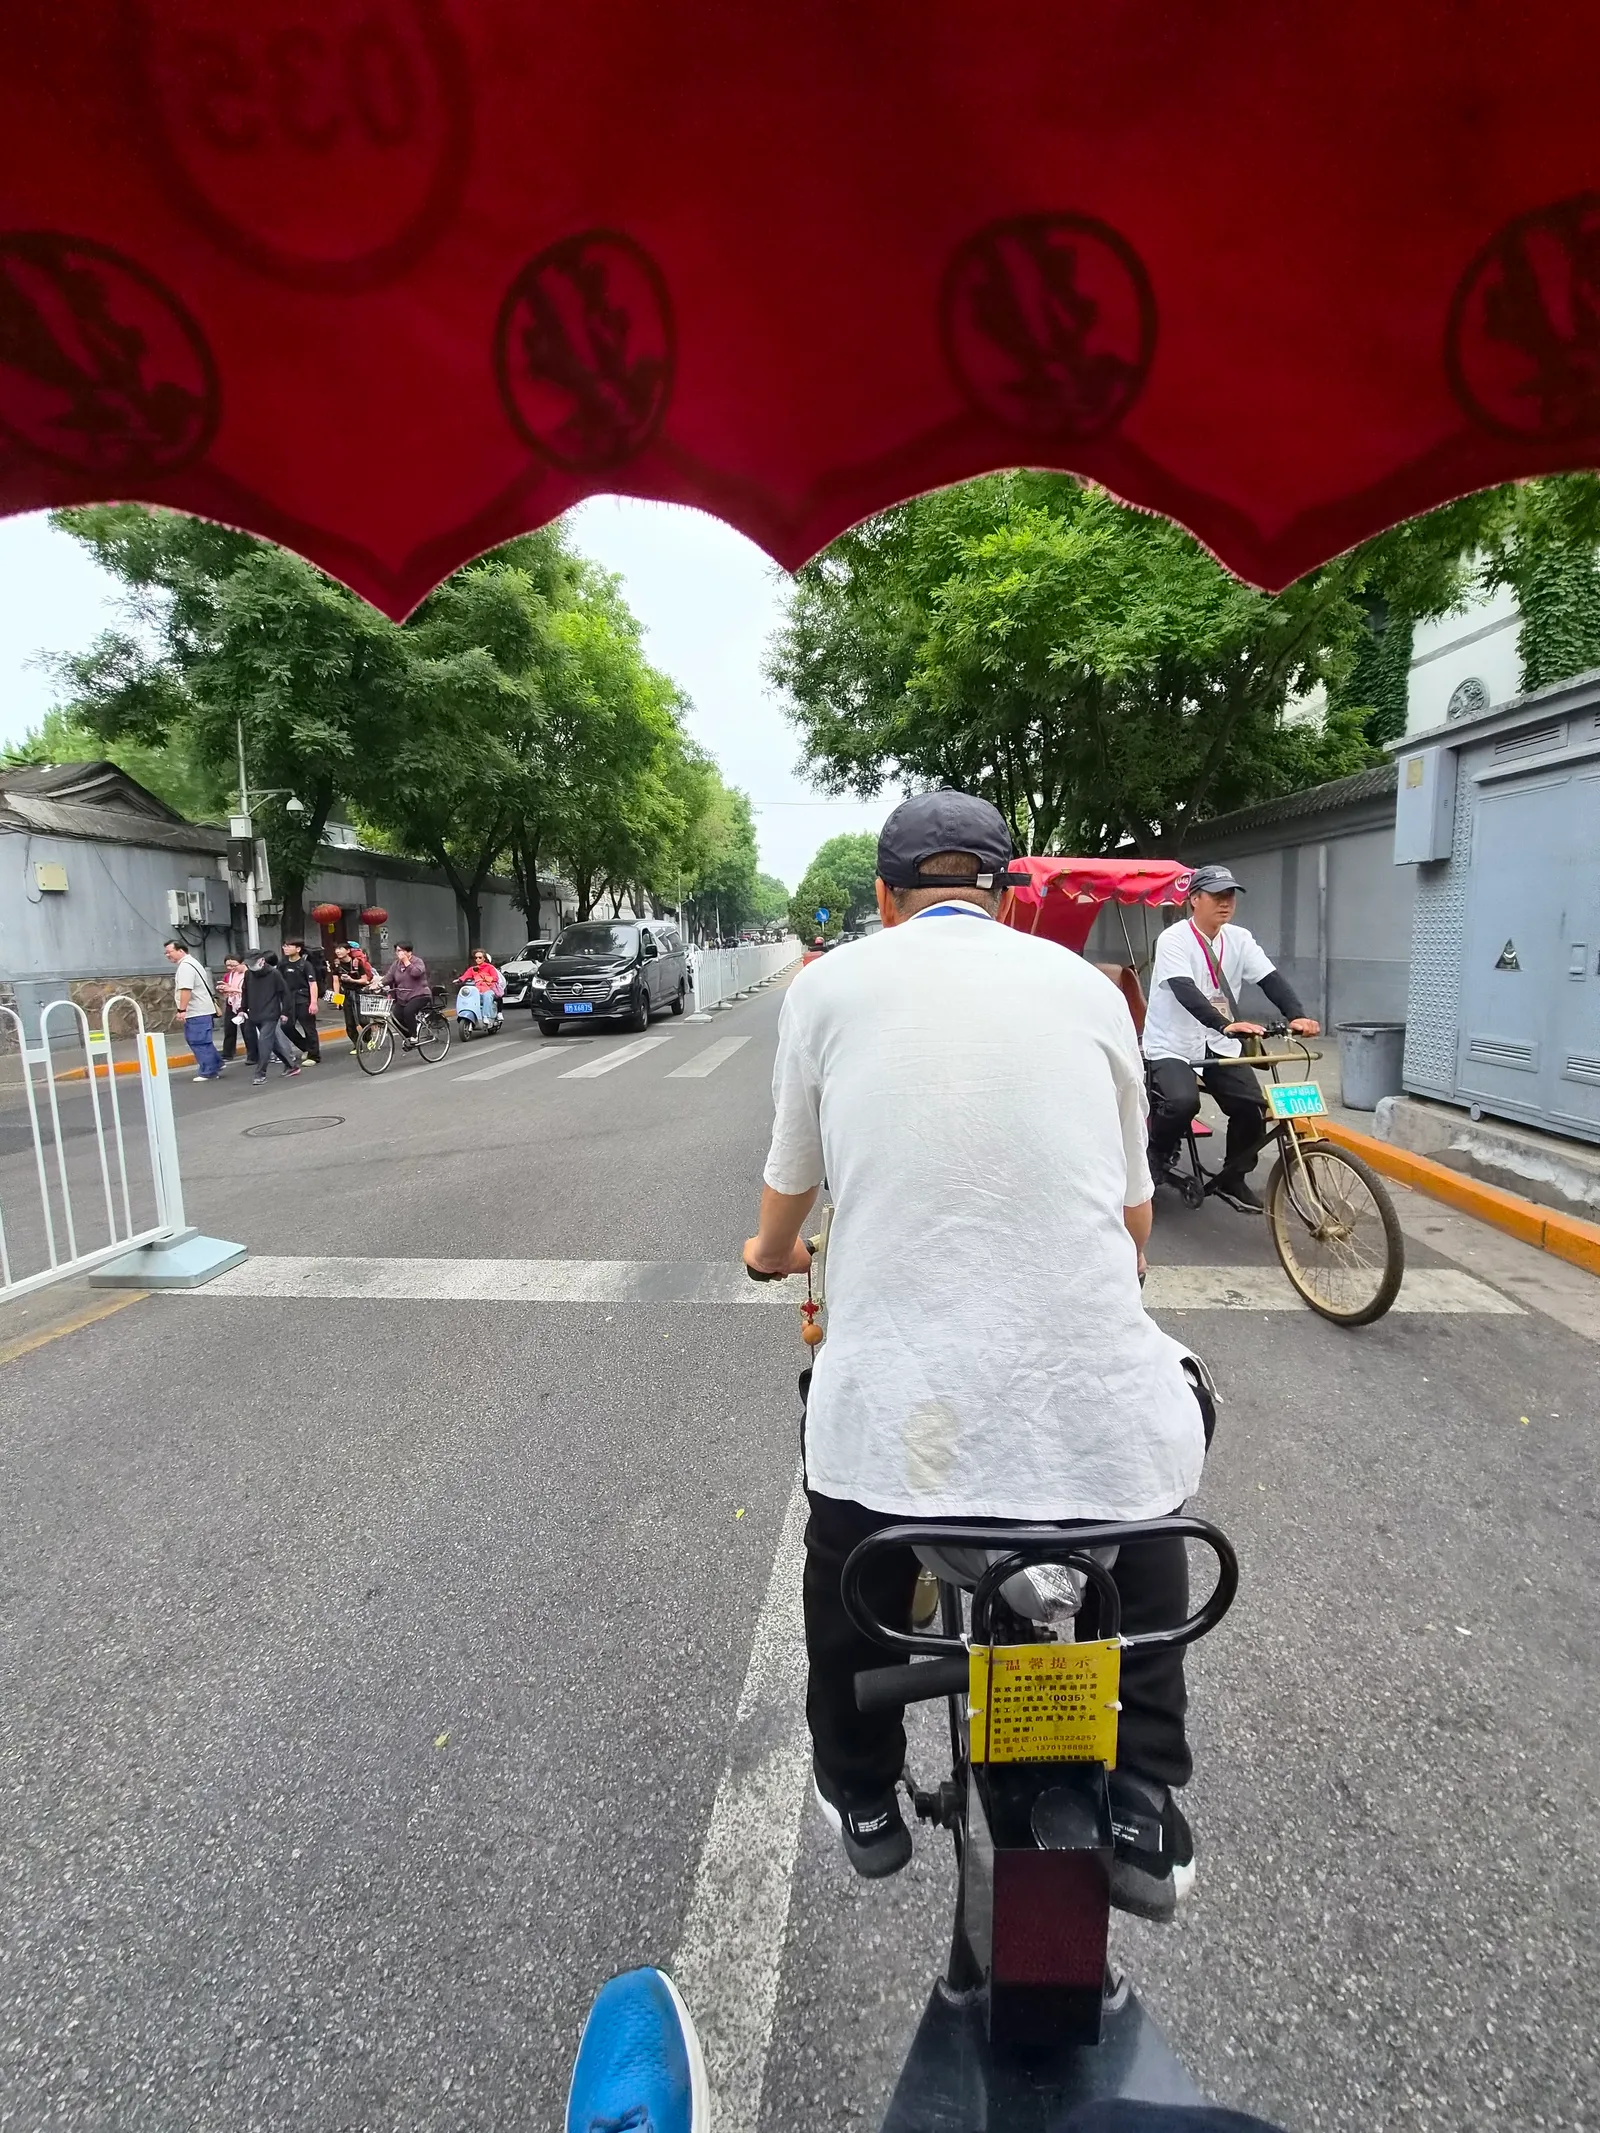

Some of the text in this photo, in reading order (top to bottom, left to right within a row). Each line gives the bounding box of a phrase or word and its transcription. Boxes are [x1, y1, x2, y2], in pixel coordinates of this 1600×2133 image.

[1290, 1098, 1323, 1114] 0046
[1006, 1656, 1090, 1671] 温馨提示
